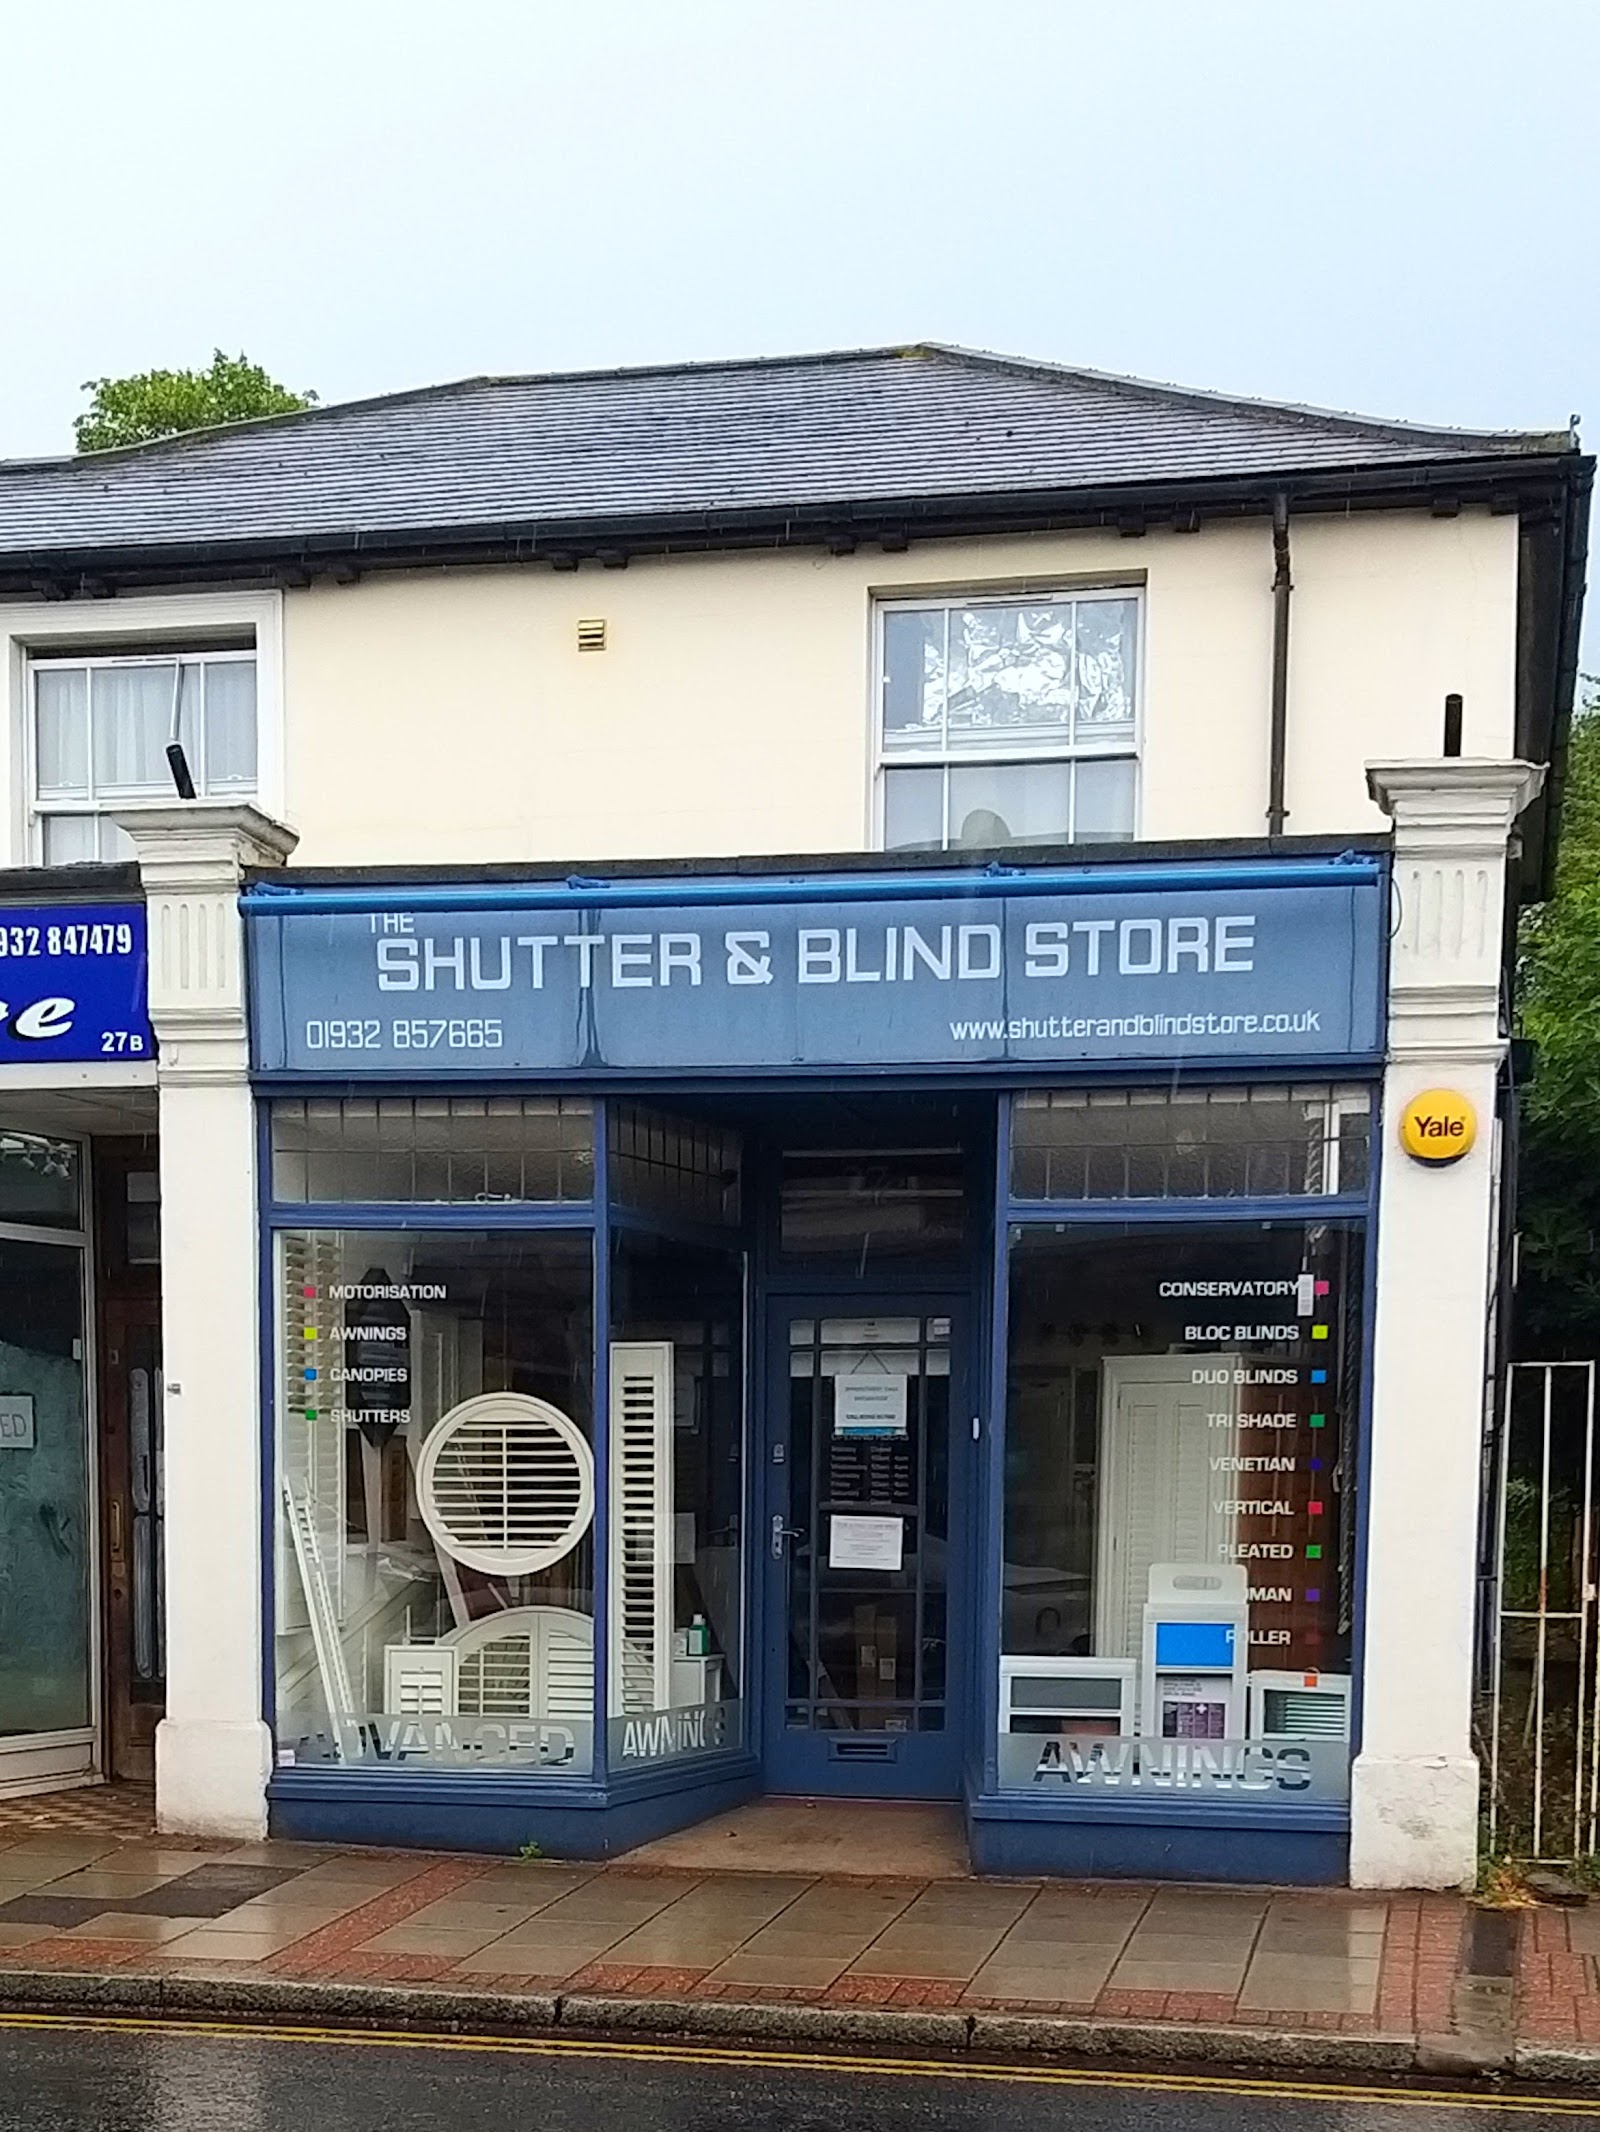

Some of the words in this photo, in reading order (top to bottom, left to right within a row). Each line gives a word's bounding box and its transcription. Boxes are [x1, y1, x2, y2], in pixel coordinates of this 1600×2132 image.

[370, 912, 414, 933] THE
[47, 923, 132, 956] 847479
[376, 932, 702, 991] SHUTTER
[725, 930, 773, 985] &
[798, 924, 1000, 984] BLIND
[1025, 915, 1256, 978] STORE
[949, 1009, 1321, 1042] www.shutterandblindstore.co.uk
[306, 1020, 380, 1049] 01932
[393, 1019, 502, 1049] 857665
[1413, 1115, 1464, 1138] Yale
[329, 1284, 447, 1299] MOTORISATION
[1159, 1280, 1300, 1297] CONSERVATORY
[329, 1326, 407, 1341] AWNINGS
[1184, 1326, 1231, 1341] BLOC
[1235, 1325, 1299, 1341] BLINDS
[329, 1367, 408, 1382] CANOPIES
[1191, 1370, 1229, 1384] DUO
[1233, 1369, 1298, 1384] BLINDS
[330, 1409, 411, 1424] SHUTTERS
[1207, 1415, 1232, 1429] TRI
[1236, 1414, 1296, 1428] SHADE
[1209, 1457, 1296, 1472] VENETIAN
[1212, 1500, 1295, 1515] VERTICAL
[1217, 1544, 1294, 1559] PLEATED
[1225, 1629, 1292, 1646] RLLER
[1032, 1740, 1311, 1791] AWNINGS
